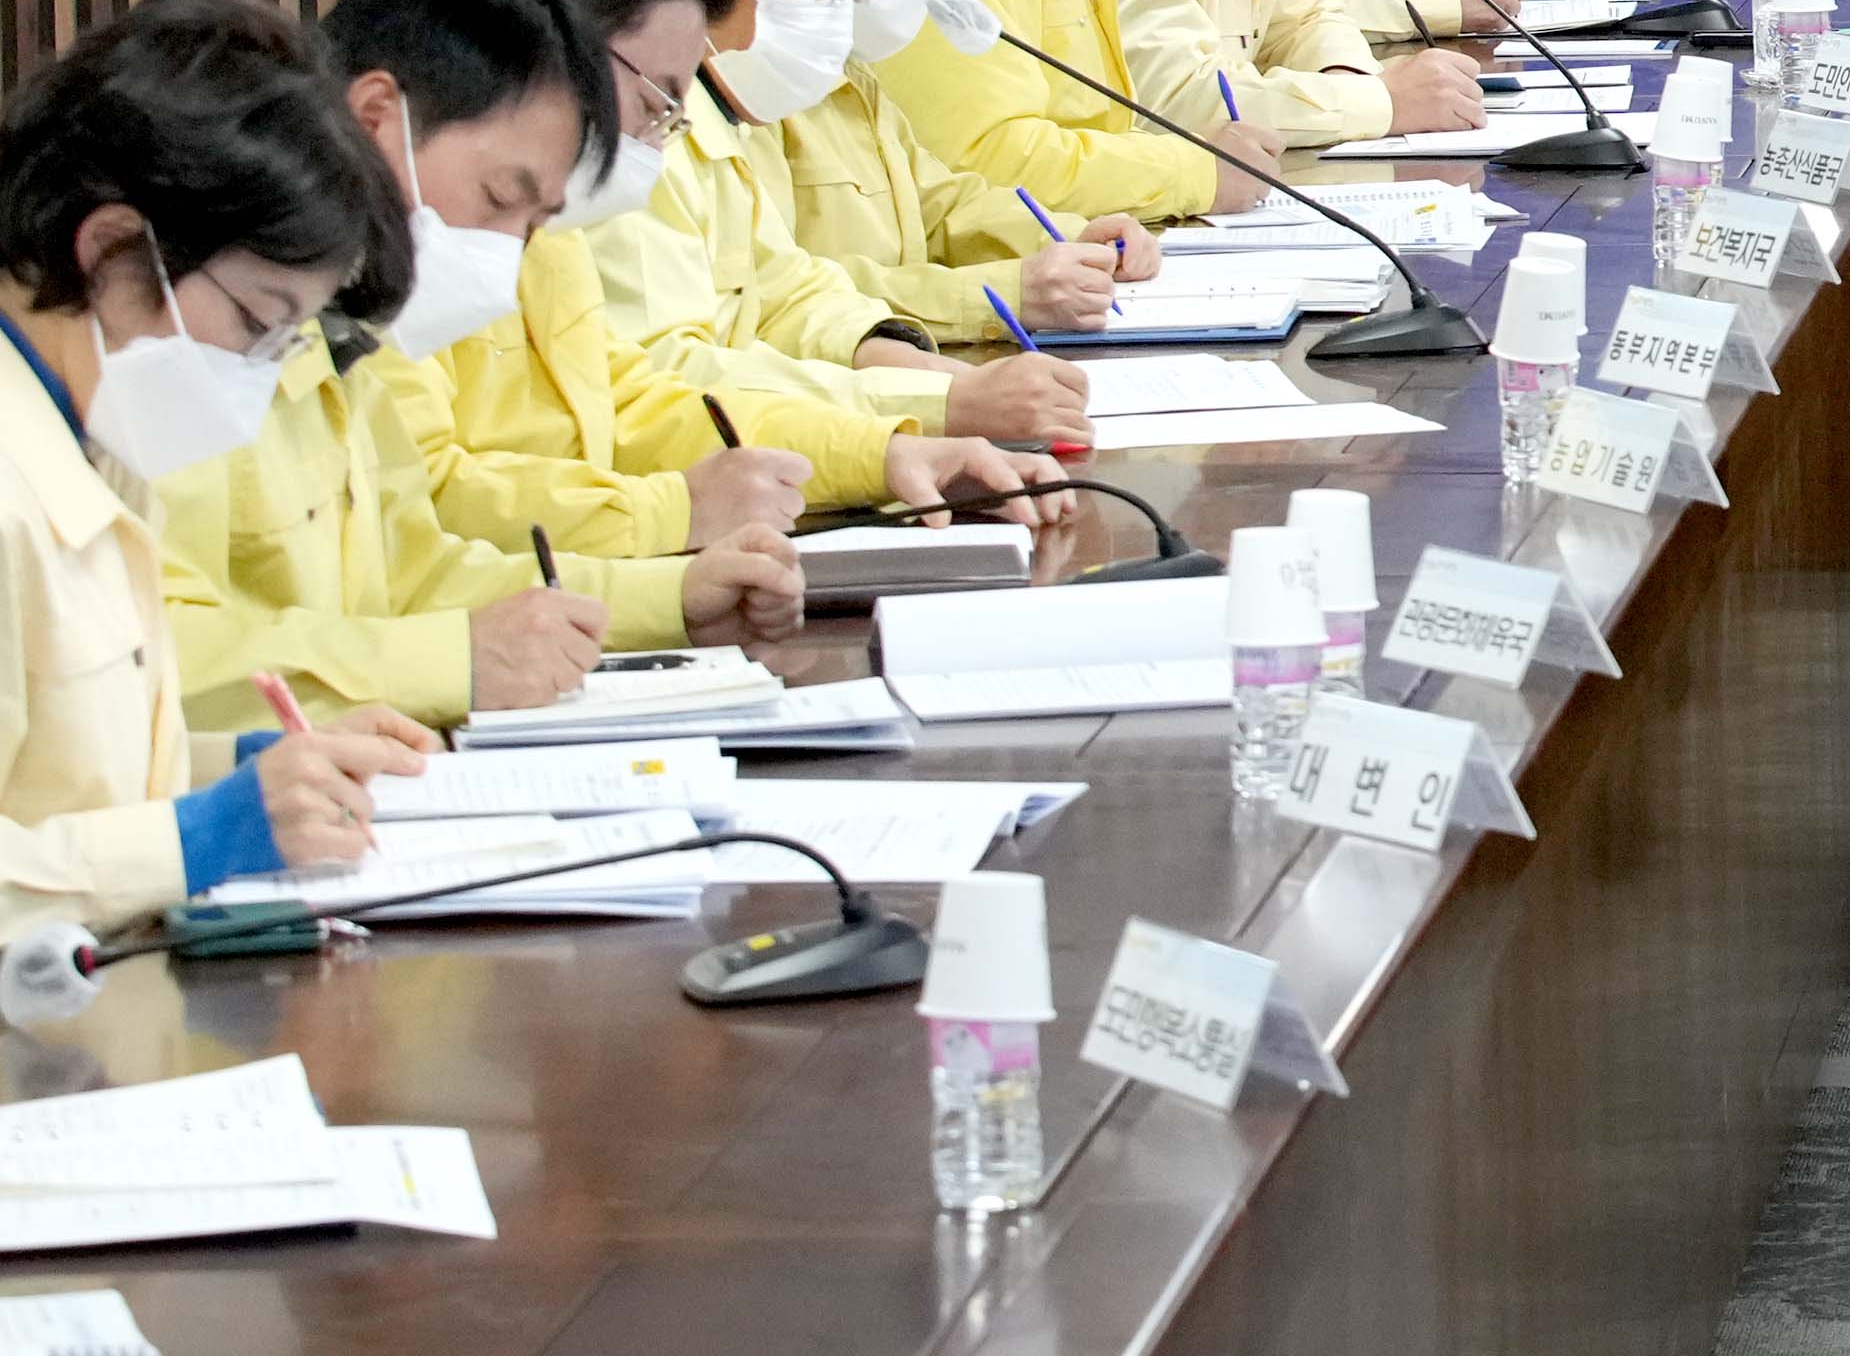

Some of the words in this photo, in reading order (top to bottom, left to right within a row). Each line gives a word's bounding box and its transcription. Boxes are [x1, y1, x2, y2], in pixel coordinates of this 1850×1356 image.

[1760, 144, 1844, 189] 농축산식품국
[1688, 221, 1777, 273] 보건복지국
[1609, 329, 1719, 380] 동부지역본부
[1549, 438, 1659, 493] 농업기술원
